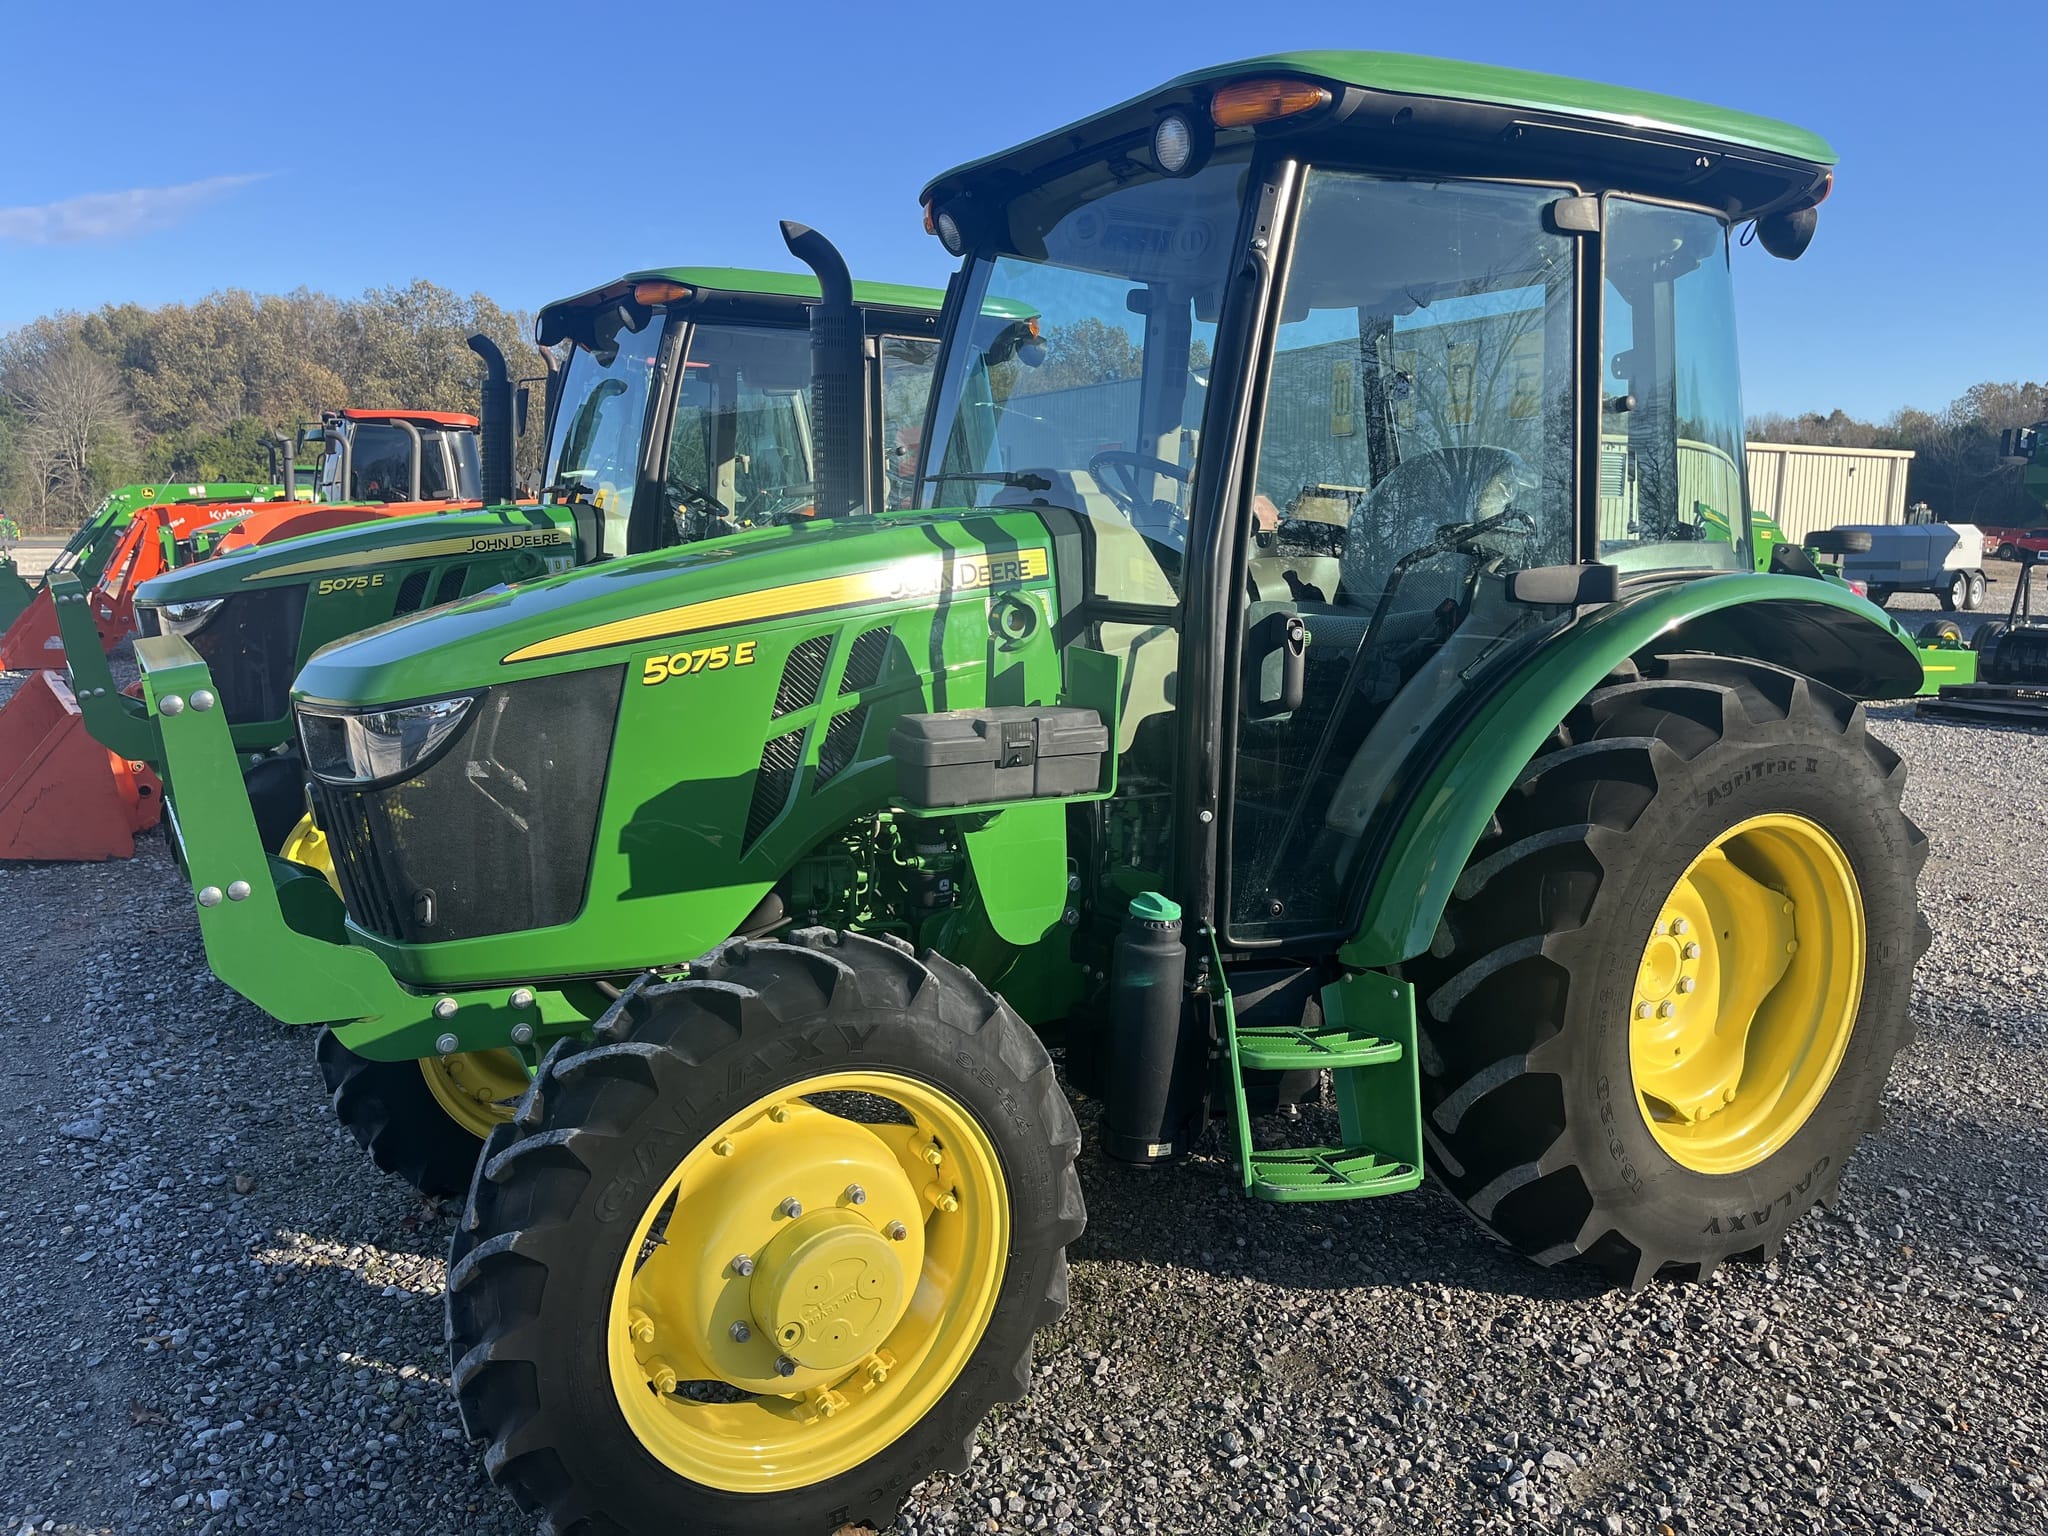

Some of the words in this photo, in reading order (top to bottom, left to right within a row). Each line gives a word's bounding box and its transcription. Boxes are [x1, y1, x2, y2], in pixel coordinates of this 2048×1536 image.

[209, 507, 254, 520] Kubota
[467, 538, 509, 553] JOHN
[512, 533, 561, 549] DEERE
[319, 576, 368, 596] 5075
[370, 574, 385, 588] E
[960, 560, 1030, 584] DEERE
[642, 645, 731, 686] 5075
[735, 640, 757, 666] E
[1706, 760, 1797, 809] AgriTrac
[955, 1051, 1033, 1137] 9.5-24
[593, 1022, 881, 1224] GALAXY
[1702, 1155, 1831, 1236] GALAXY
